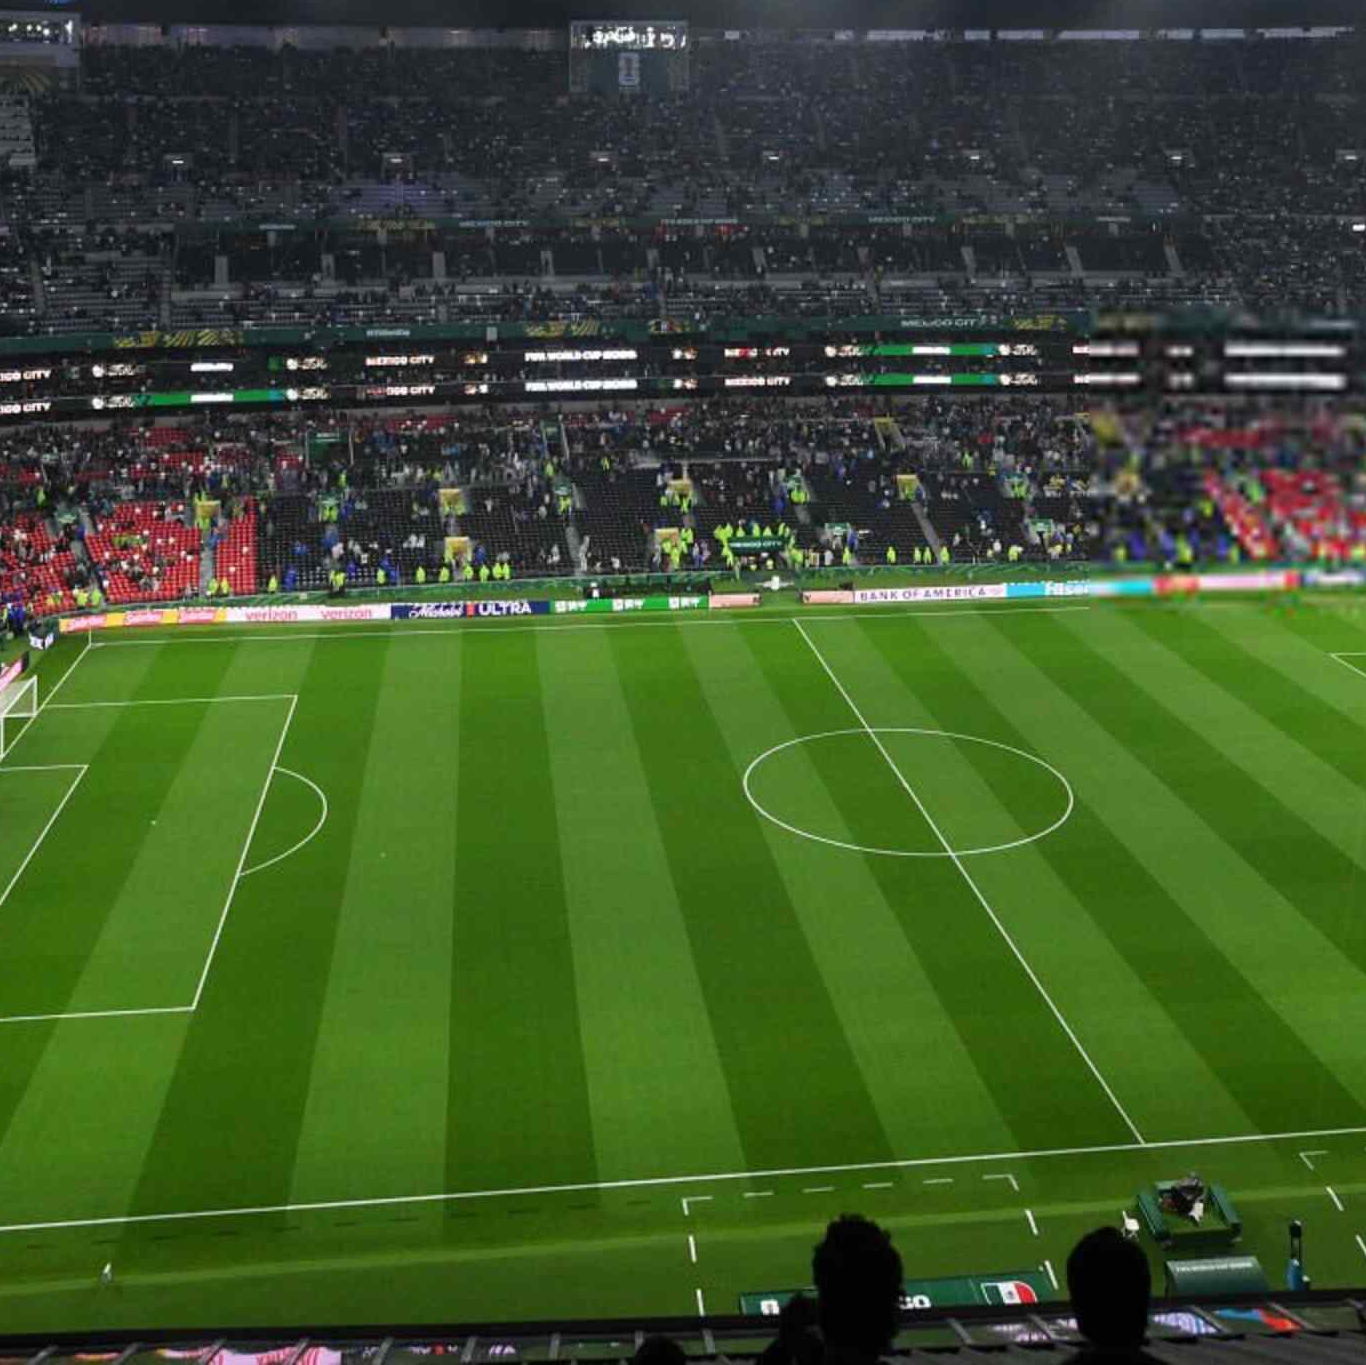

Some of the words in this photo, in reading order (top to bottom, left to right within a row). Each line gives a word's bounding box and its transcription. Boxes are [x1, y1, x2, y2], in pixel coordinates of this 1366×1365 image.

[860, 591, 898, 602] BANK
[902, 590, 921, 600] OF
[922, 587, 987, 599] AMERICA
[244, 609, 299, 620] verizon
[320, 608, 373, 619] verizon
[478, 600, 532, 616] ULTRA
